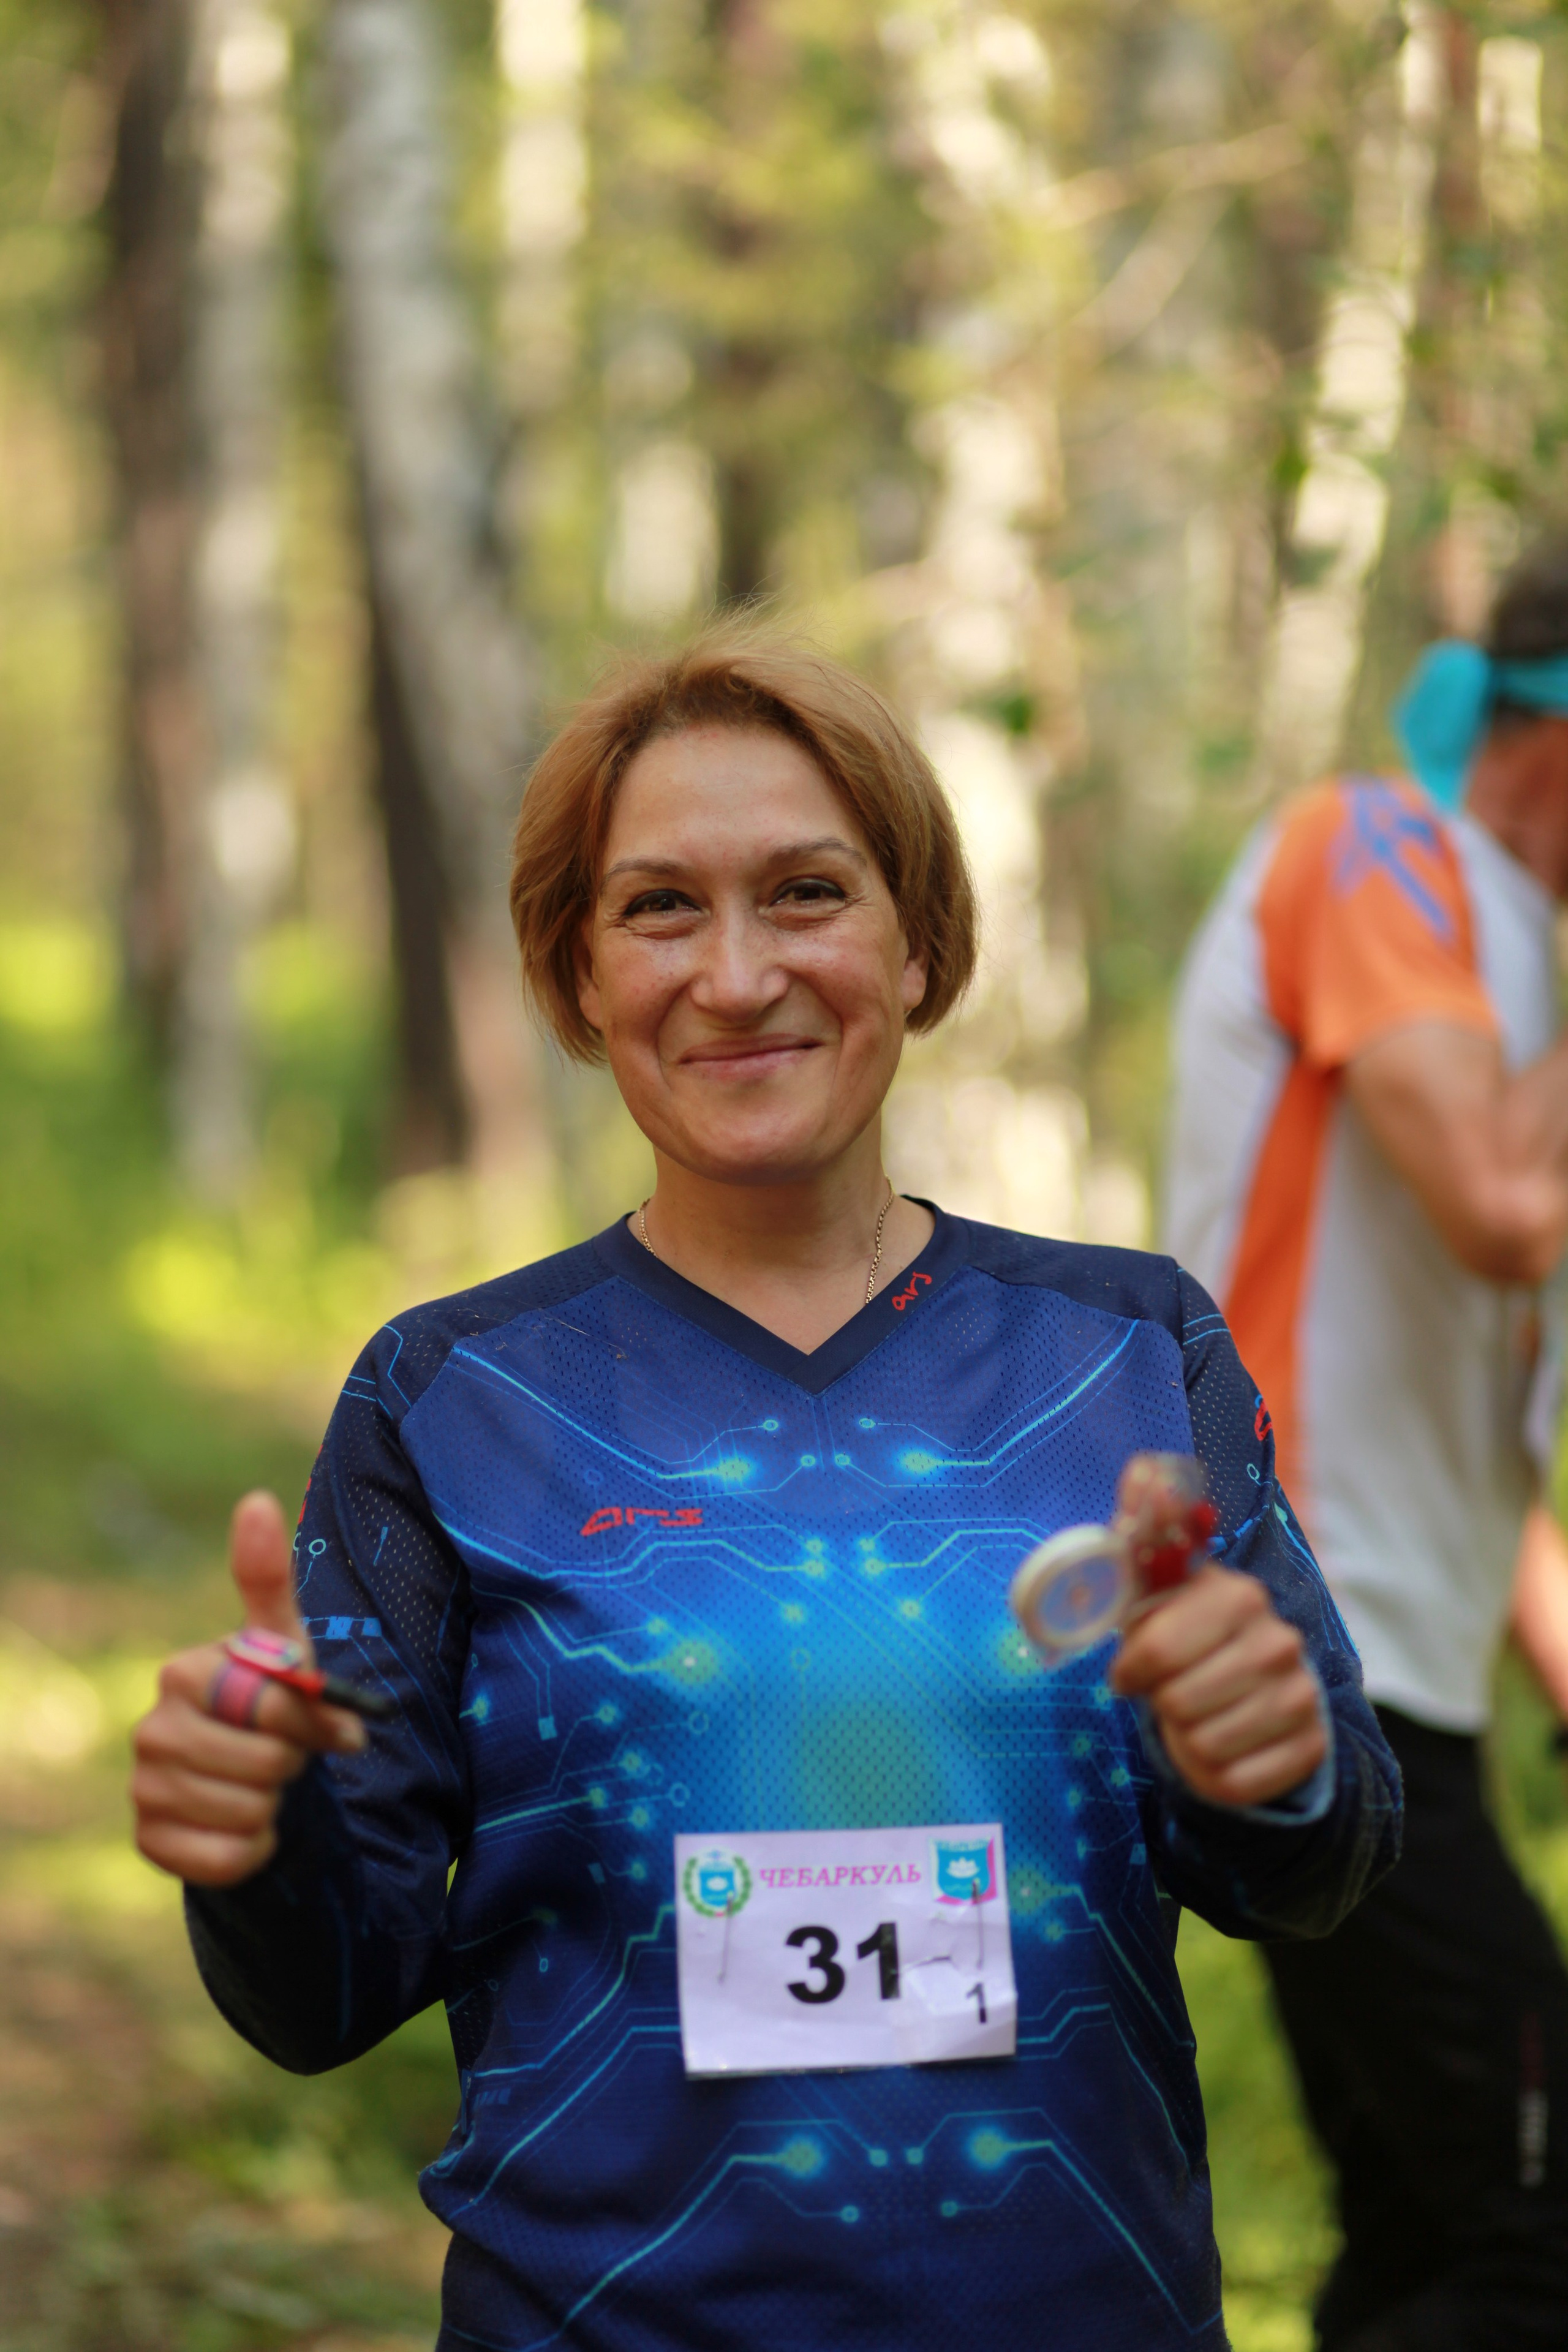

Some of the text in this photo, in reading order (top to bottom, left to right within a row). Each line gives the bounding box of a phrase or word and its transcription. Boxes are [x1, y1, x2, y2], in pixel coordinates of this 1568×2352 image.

[759, 1864, 922, 1888] ЧЕБАРКУЛЬ
[785, 1921, 900, 2003] 31
[966, 1983, 987, 2024] 1
